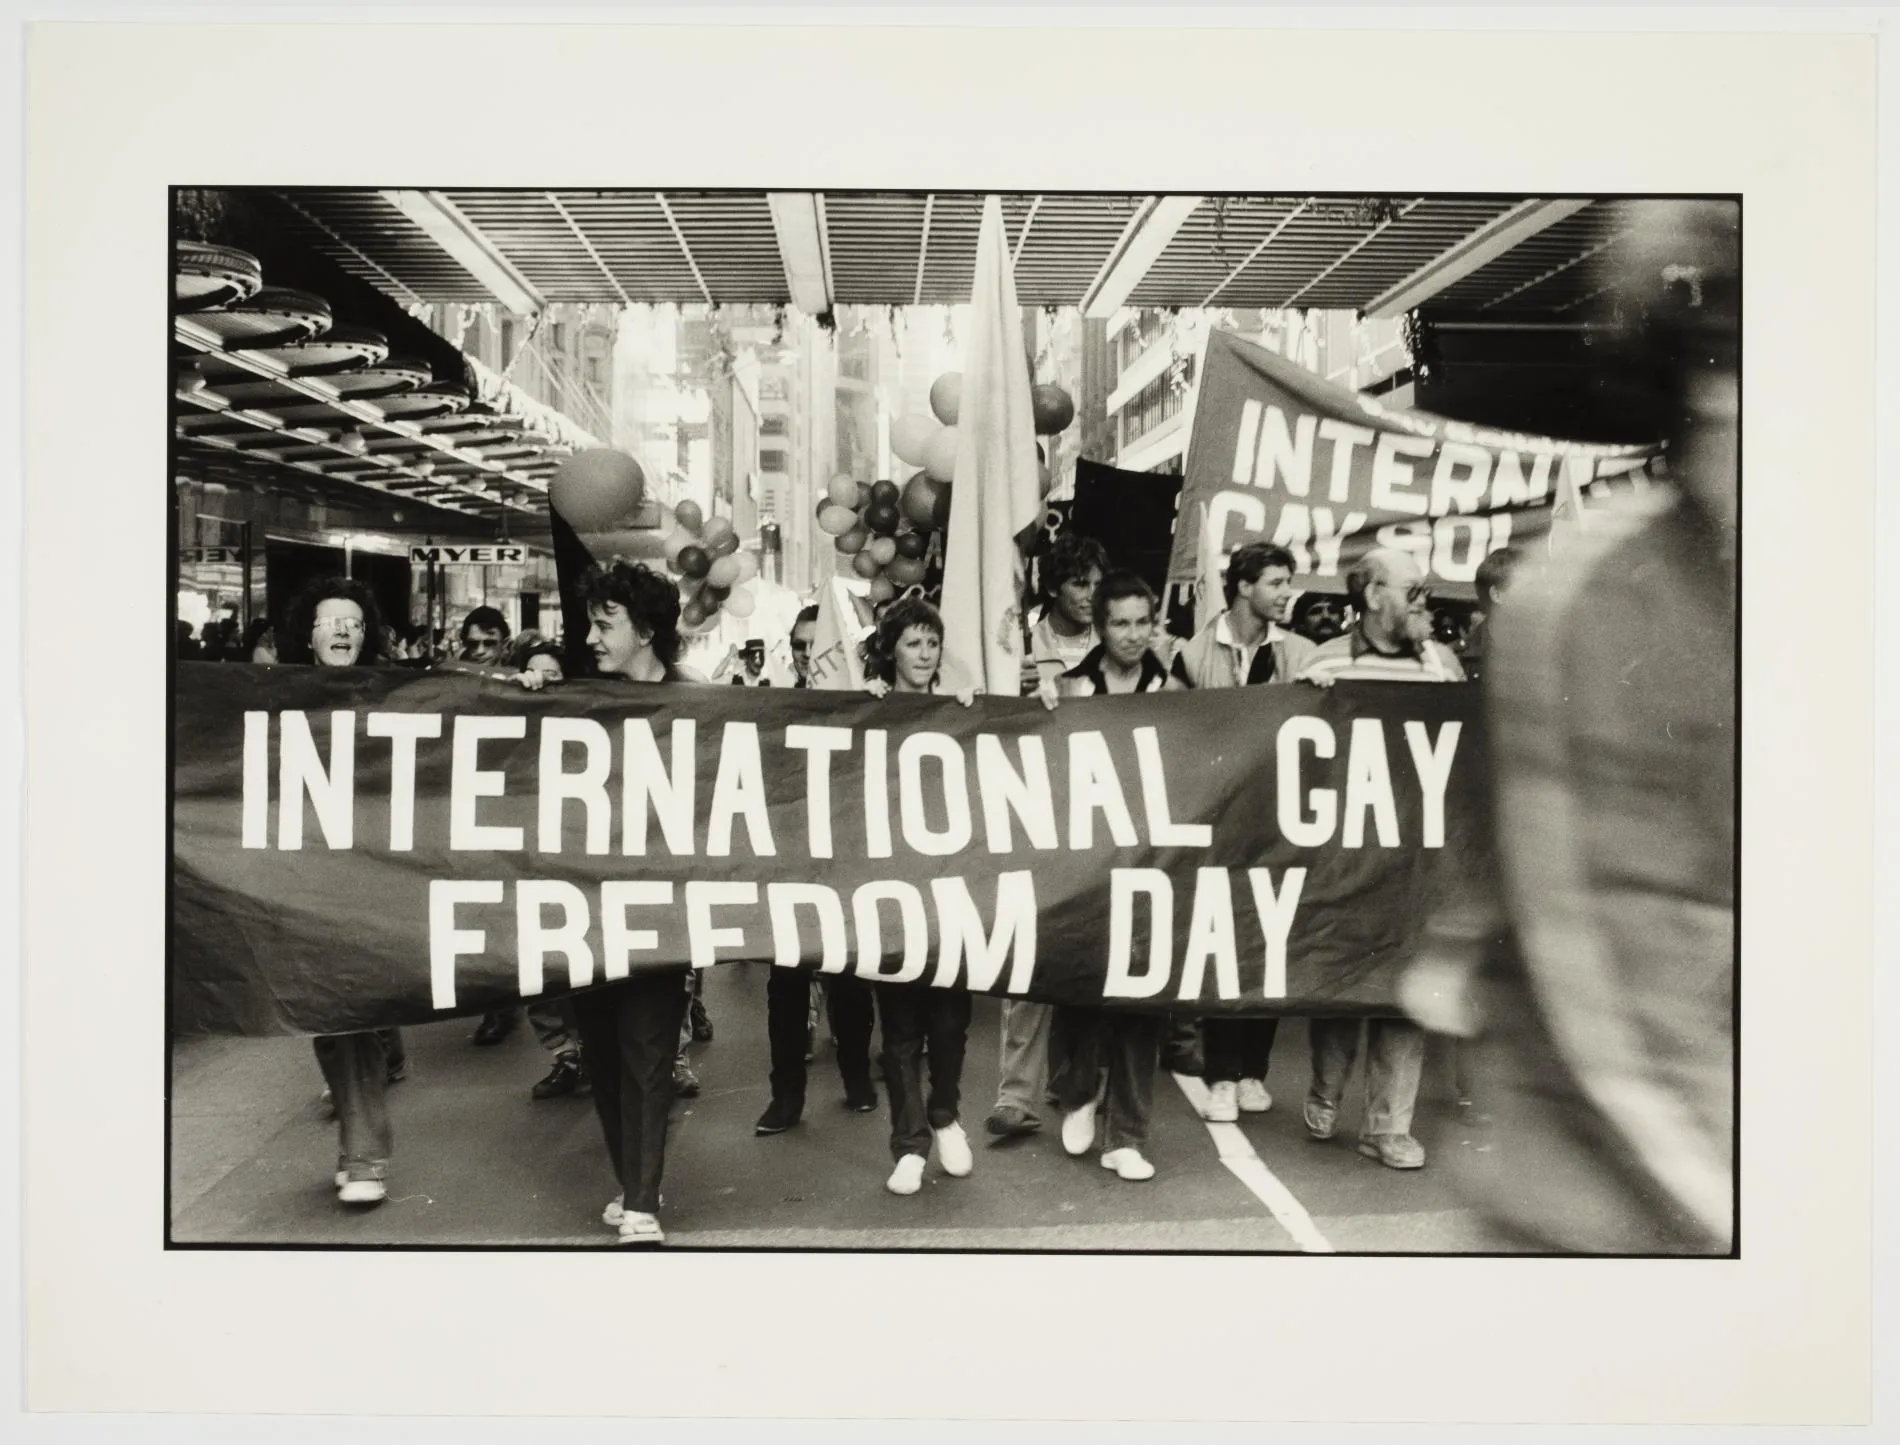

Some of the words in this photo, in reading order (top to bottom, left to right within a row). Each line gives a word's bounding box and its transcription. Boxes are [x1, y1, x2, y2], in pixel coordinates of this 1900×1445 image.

[412, 548, 522, 561] MYER
[242, 710, 1212, 858] INTERNATIONAL
[1276, 715, 1462, 849] GAY
[1103, 866, 1307, 1000] DAY
